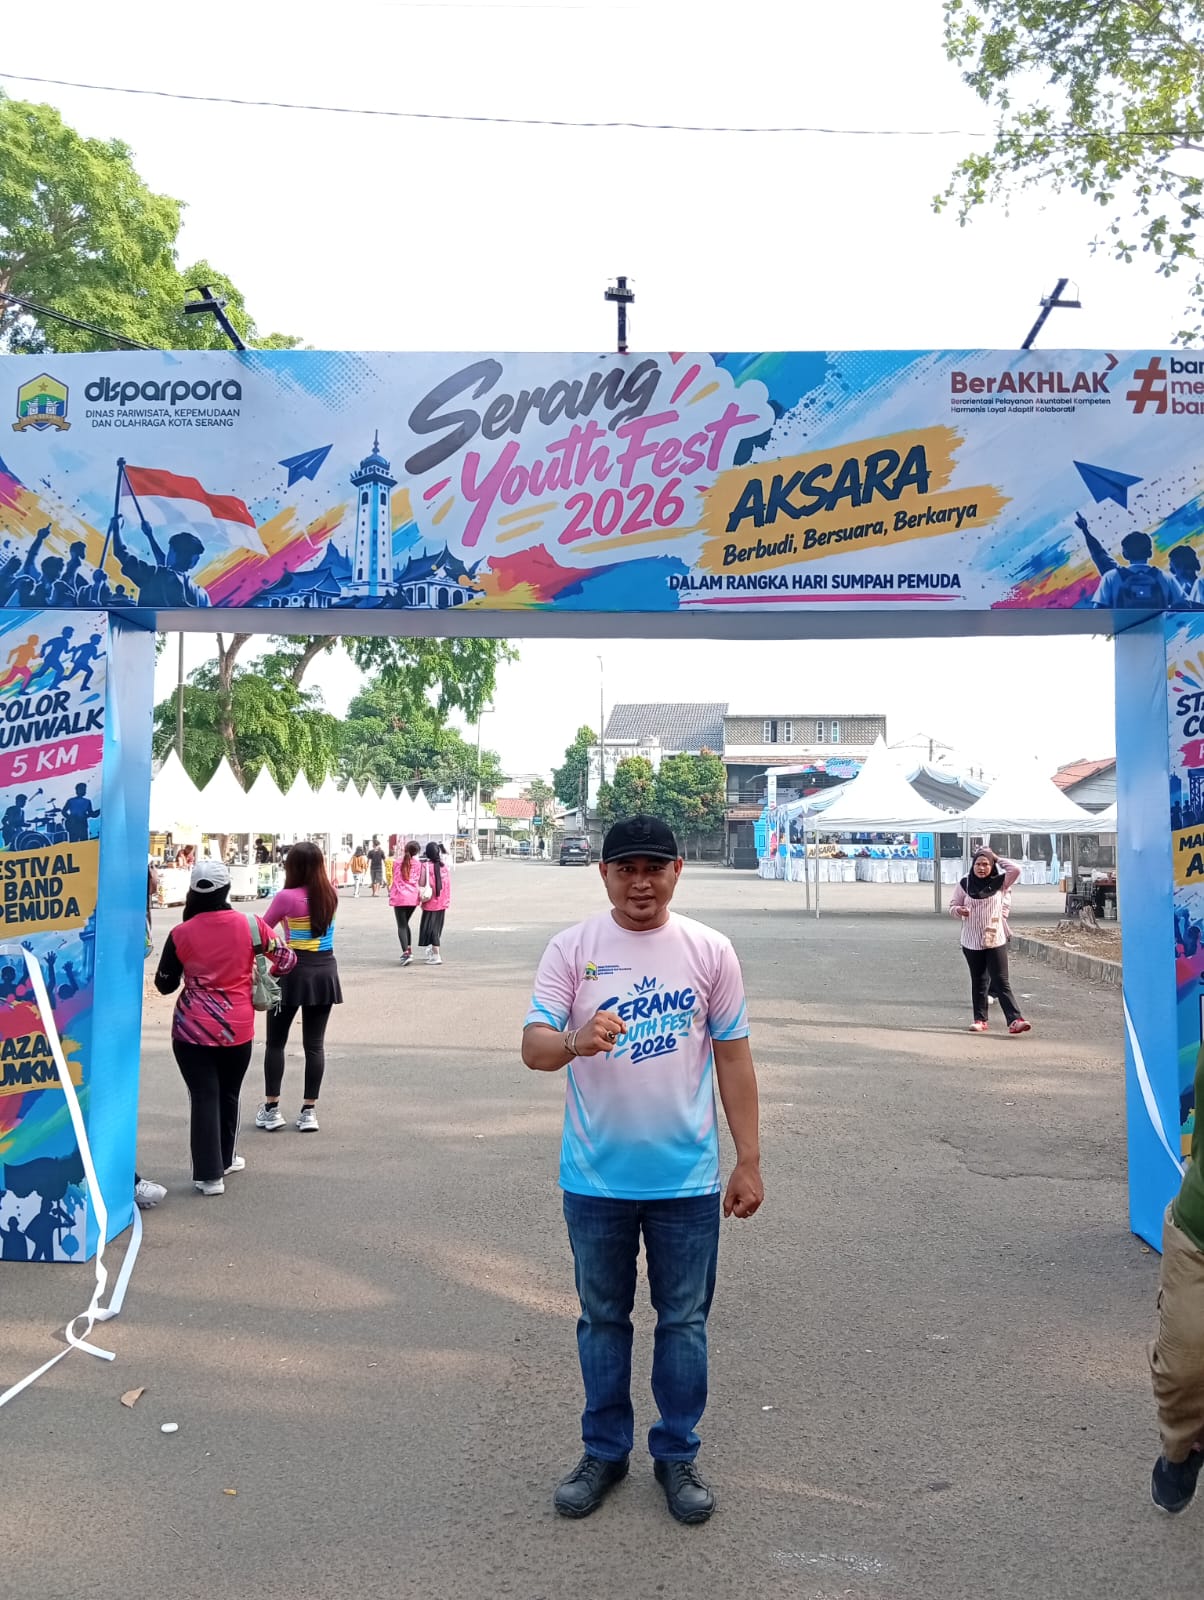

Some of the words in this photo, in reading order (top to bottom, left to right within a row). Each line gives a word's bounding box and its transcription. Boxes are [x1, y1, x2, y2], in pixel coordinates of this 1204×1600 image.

[84, 376, 242, 406] disparpora
[951, 371, 1111, 394] BerAKHLAK
[85, 409, 114, 418] DINAS
[117, 409, 172, 418] PARIWISATA,
[174, 408, 240, 417] KEPEMUDAAN
[951, 398, 994, 406] Berorientasi
[995, 398, 1034, 407] Pelayanan
[1074, 398, 1111, 406] Kompeten
[951, 405, 986, 413] Harmonis
[987, 405, 1007, 414] Loyal
[1008, 405, 1034, 414] Adaptif
[1035, 405, 1075, 413] Kolaboratif
[92, 419, 112, 428] DAN
[114, 418, 166, 428] OLAHRAGA
[168, 418, 193, 427] KOTA
[195, 418, 234, 427] SERANG
[404, 358, 662, 476] Serang
[461, 420, 615, 547] Youth
[616, 402, 760, 488] Fest
[725, 444, 931, 533] AKSARA
[557, 478, 685, 545] 2026
[722, 533, 798, 566] Berbudi,
[803, 519, 889, 551] Bersuara,
[893, 503, 977, 533] Berkarya
[669, 574, 723, 591] DALAM
[726, 574, 789, 590] RANGKA
[792, 574, 828, 590] HARI
[831, 574, 894, 590] SUMPAH
[897, 573, 962, 589] PEMUDA
[1176, 691, 1204, 717] ST
[0, 707, 105, 749] UNWALK
[1183, 714, 1204, 738] C
[11, 753, 29, 779] 5
[36, 744, 79, 772] KM
[809, 845, 836, 857] AARA
[1179, 832, 1204, 852] MA
[4, 876, 63, 902] BAND
[611, 1018, 657, 1051] OUTH
[661, 1009, 695, 1034] FEST
[0, 1034, 60, 1061] AZA
[630, 1033, 677, 1060] 2026
